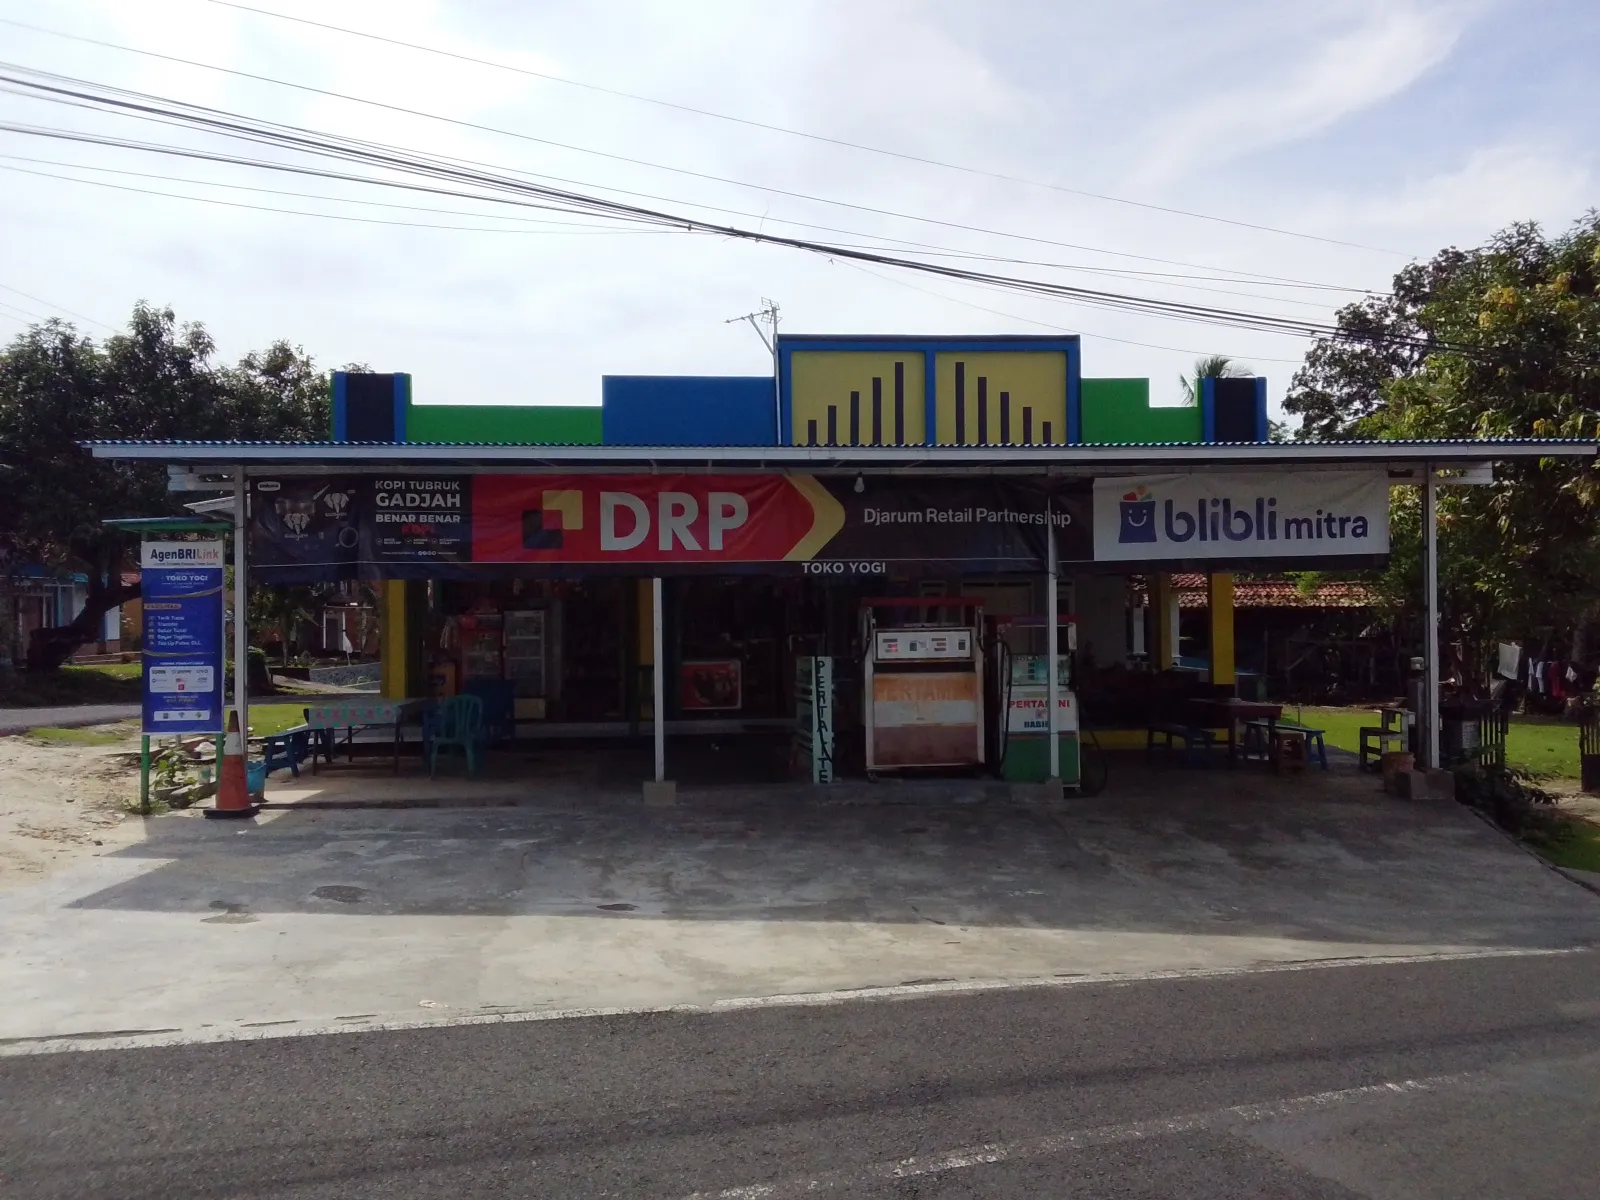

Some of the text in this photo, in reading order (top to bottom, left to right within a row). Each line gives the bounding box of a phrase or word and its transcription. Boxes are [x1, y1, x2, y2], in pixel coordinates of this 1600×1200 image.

[375, 481, 460, 490] KOPI TUBRUK
[375, 493, 460, 507] GADJAH
[375, 514, 461, 523] BENAR BENAR
[600, 491, 749, 551] DRP
[863, 508, 1071, 528] Djarum Retail Partnership
[1164, 498, 1368, 542] blibli mitra
[150, 548, 219, 562] AgenBRILink
[801, 562, 886, 574] TOKO YOGI
